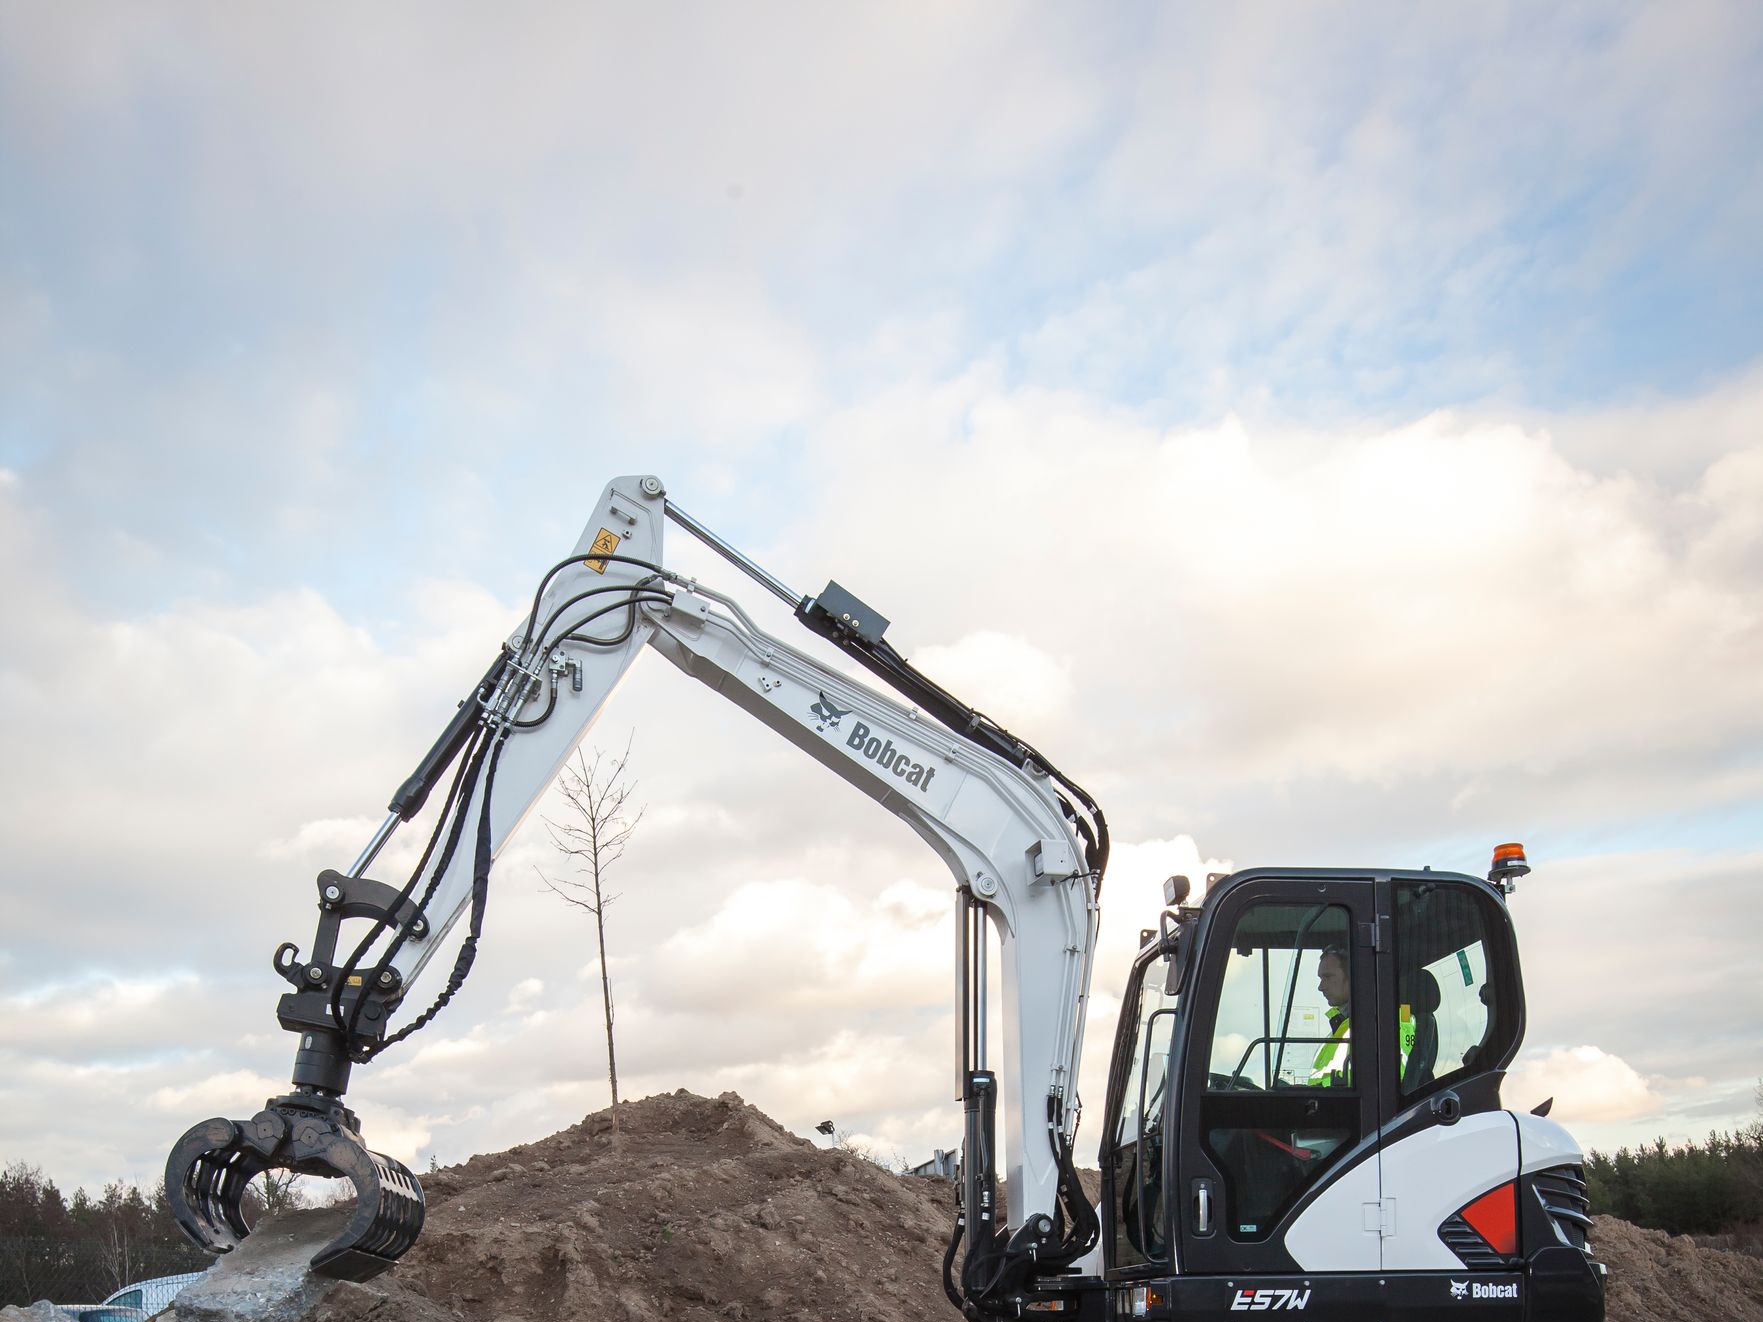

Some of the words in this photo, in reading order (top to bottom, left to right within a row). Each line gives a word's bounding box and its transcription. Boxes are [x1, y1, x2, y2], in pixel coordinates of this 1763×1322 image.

[845, 720, 936, 793] Bobcat
[1230, 1289, 1311, 1311] E57W
[1472, 1282, 1518, 1298] Bobcat
